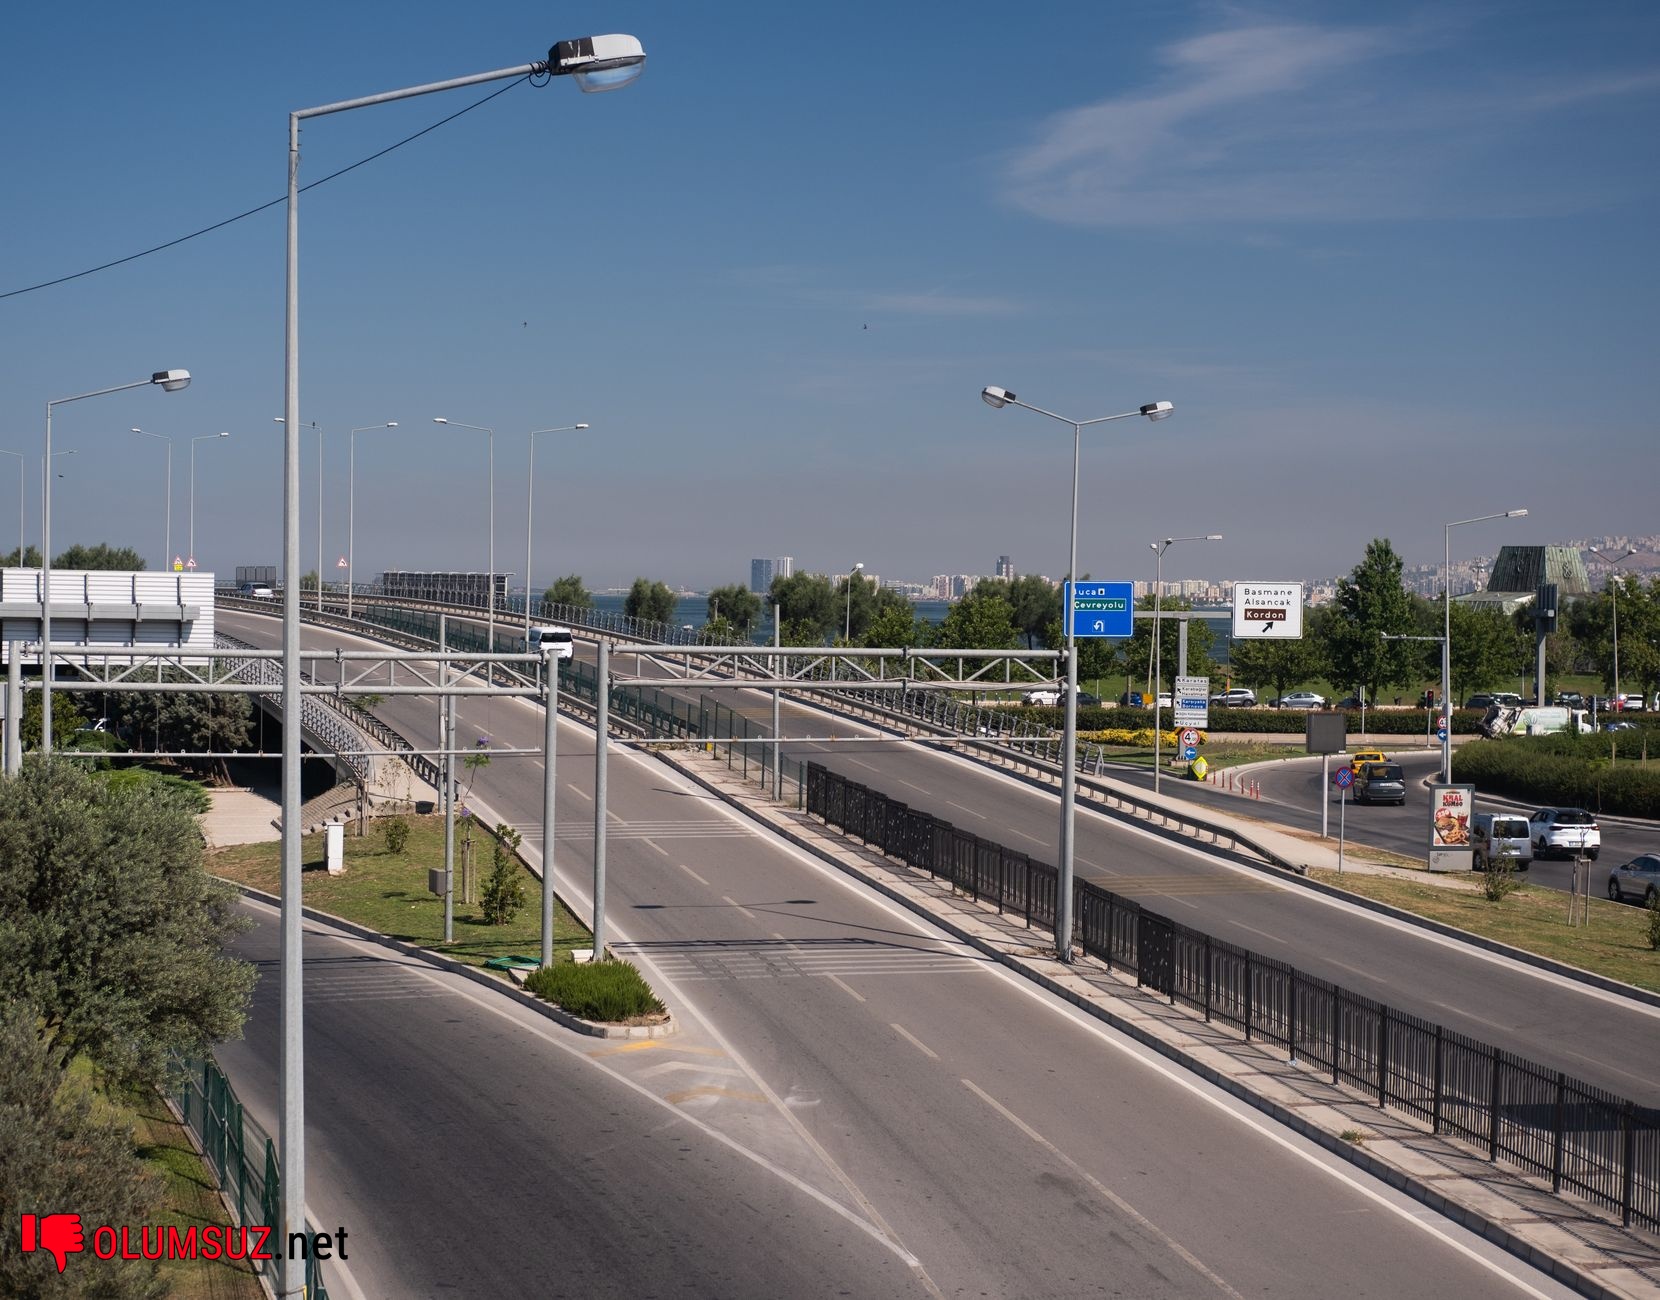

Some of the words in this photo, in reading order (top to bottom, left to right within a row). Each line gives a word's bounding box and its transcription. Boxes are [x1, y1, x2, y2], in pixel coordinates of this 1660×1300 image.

[1244, 588, 1293, 596] Basmane
[1074, 601, 1124, 610] Çevreyolu
[1244, 598, 1291, 606] Alsancak
[1246, 610, 1284, 619] Kordon
